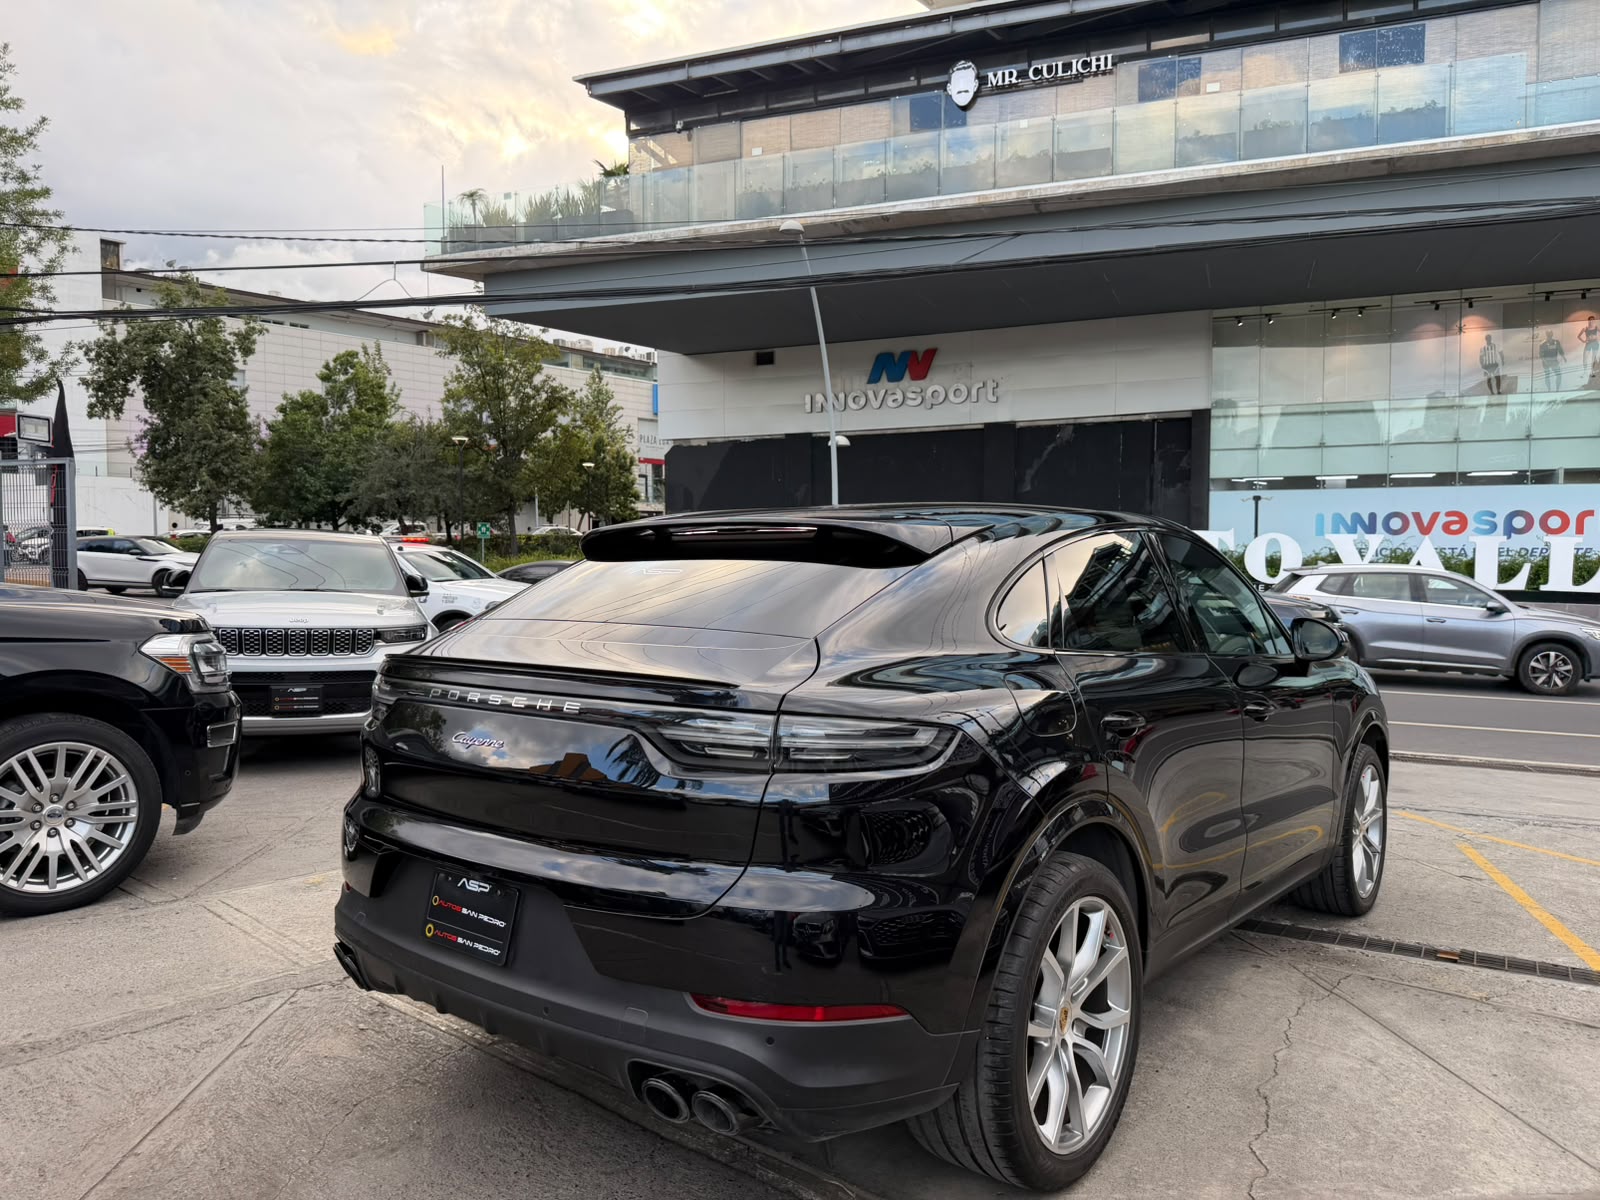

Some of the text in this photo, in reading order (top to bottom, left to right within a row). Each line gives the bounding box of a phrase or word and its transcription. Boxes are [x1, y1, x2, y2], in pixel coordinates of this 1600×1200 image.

[986, 53, 1114, 88] MR. CULICHI
[1518, 546, 1594, 559] DEPTE
[429, 688, 582, 714] PORSCHE
[451, 731, 505, 749] Cayenne
[457, 877, 491, 893] ASP
[439, 899, 505, 928] AUTOS SAN PEDRO
[434, 929, 501, 956] AUTOS SAN PEDRO
